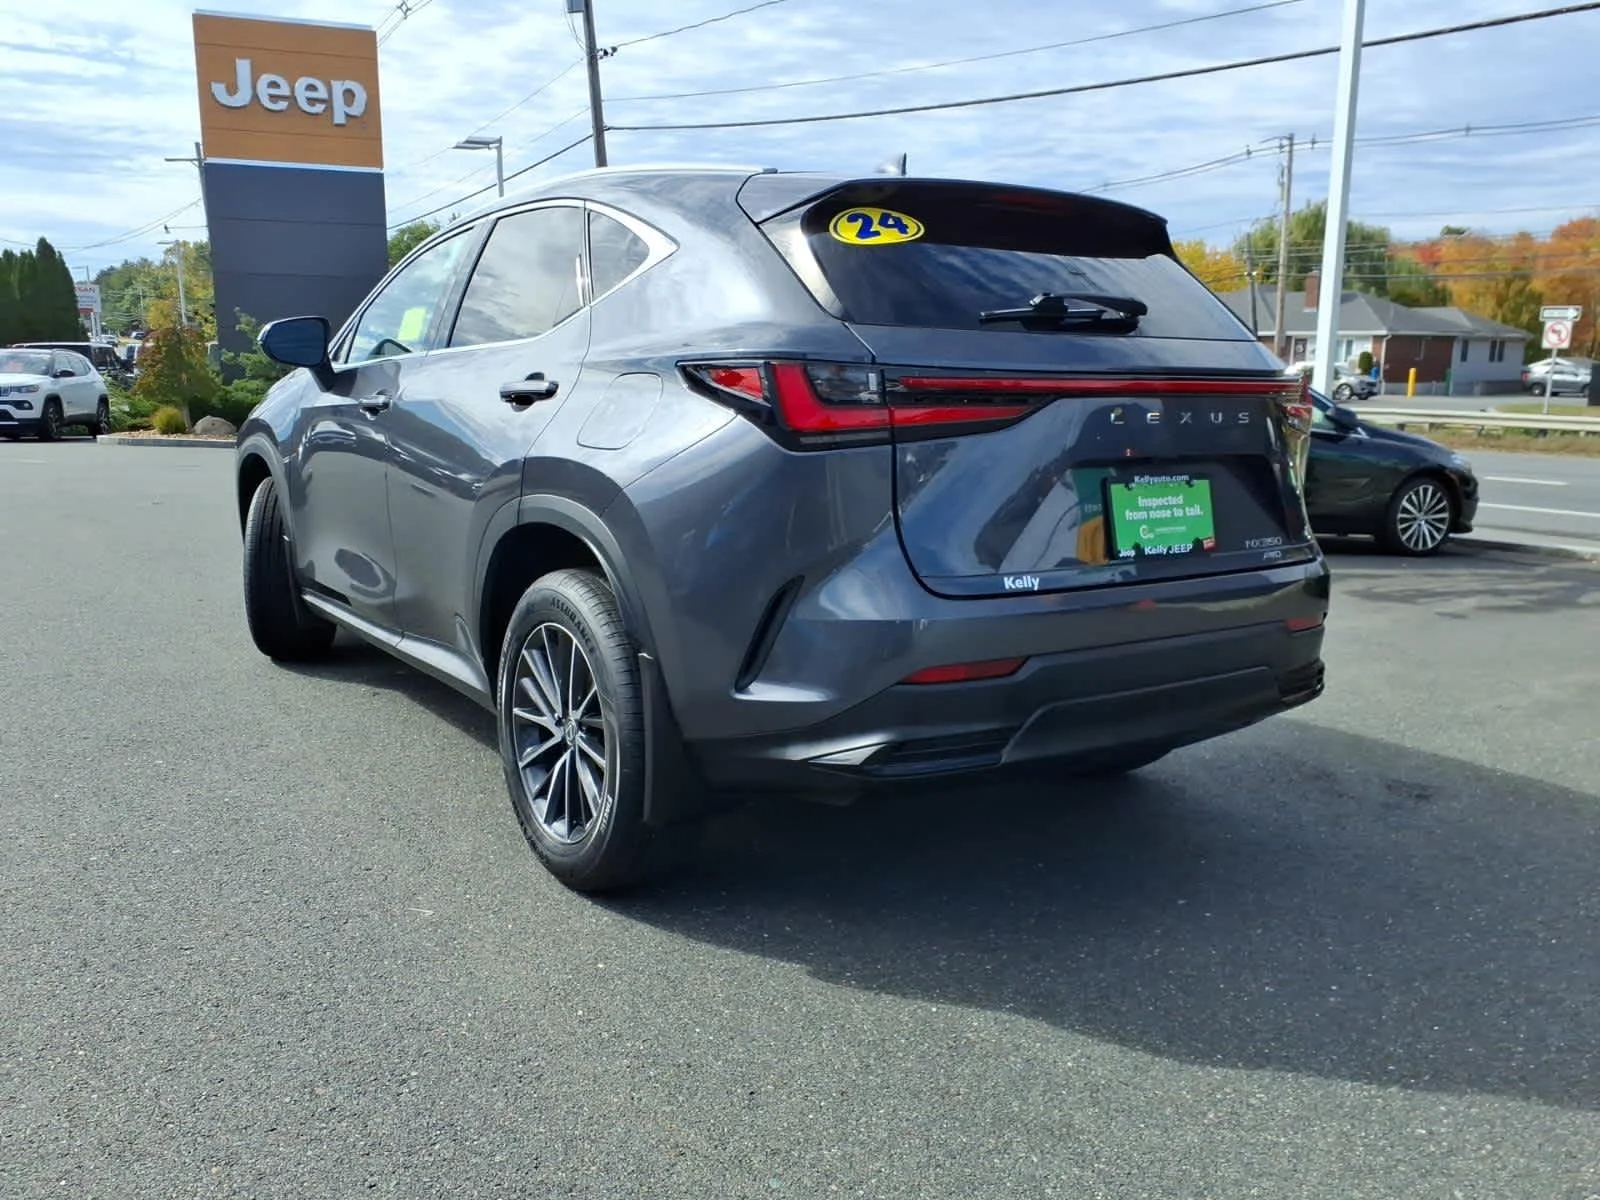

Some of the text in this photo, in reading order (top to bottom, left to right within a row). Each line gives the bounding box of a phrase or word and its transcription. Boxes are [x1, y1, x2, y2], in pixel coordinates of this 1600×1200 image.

[210, 57, 368, 127] Jeep
[846, 212, 909, 239] 24
[1110, 411, 1249, 425] LEXUS
[1138, 495, 1183, 508] Inspected
[1126, 511, 1147, 520] from
[1150, 509, 1171, 518] nose
[1174, 507, 1183, 517] to
[1144, 543, 1168, 556] Kelly
[1169, 543, 1193, 554] JEEP
[1003, 575, 1039, 591] Kelly
